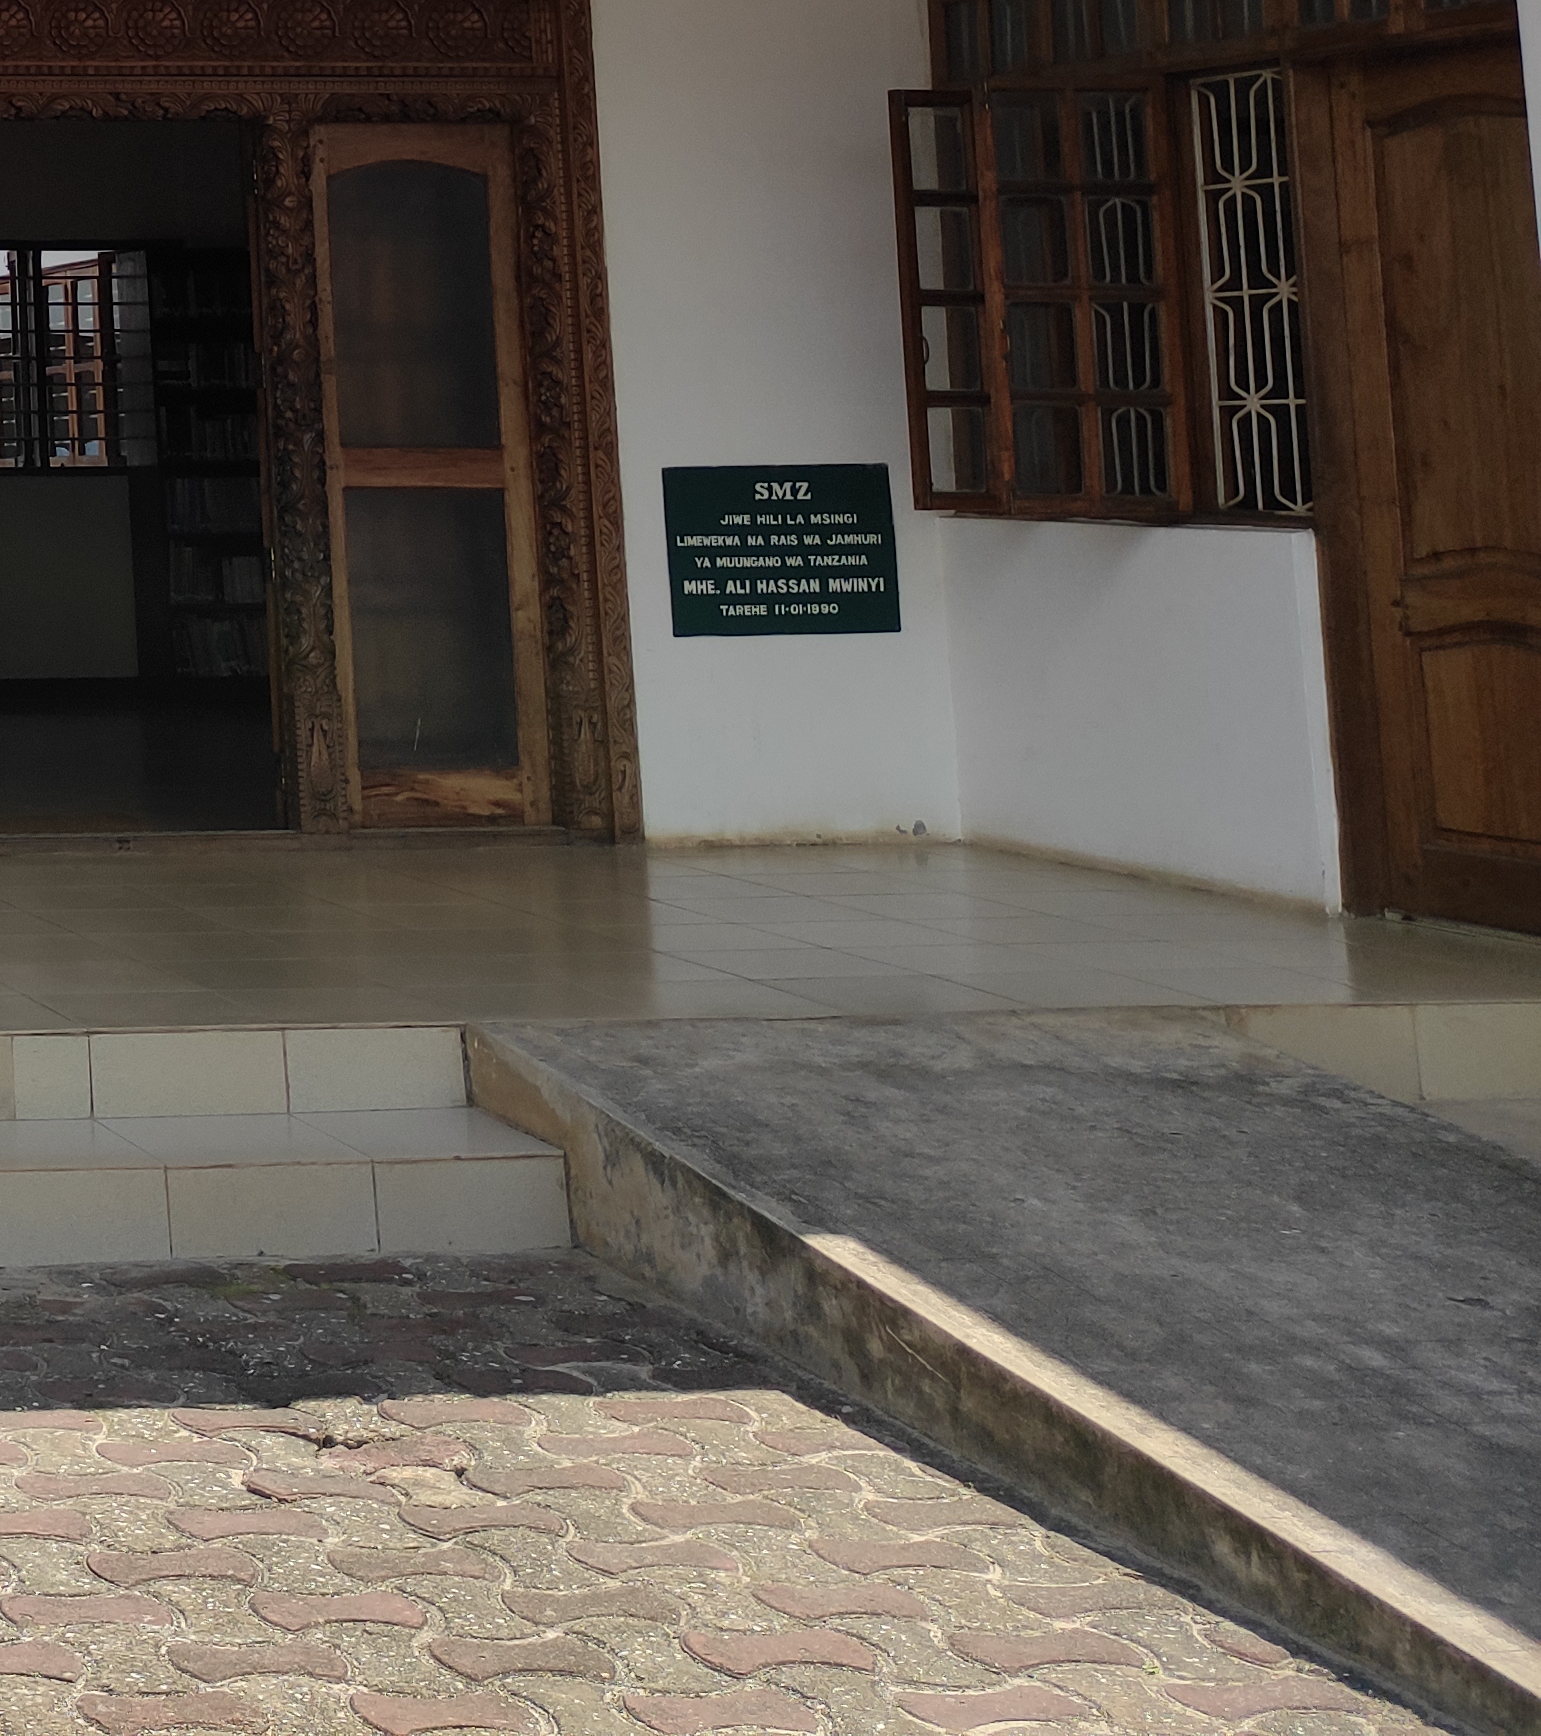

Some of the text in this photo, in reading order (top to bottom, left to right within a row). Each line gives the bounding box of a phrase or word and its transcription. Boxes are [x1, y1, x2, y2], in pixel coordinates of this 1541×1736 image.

[754, 481, 811, 500] SMZ
[719, 513, 857, 525] JIWE HILI LA MSINGI
[676, 533, 881, 546] LIMEWEKWA NA RAIS WA JAMHURI
[694, 554, 867, 567] YA MUUNGANO WA TANZANIA
[683, 577, 884, 594] MHE. ALI HASSAN MWINYI
[719, 604, 767, 616] TAREHE
